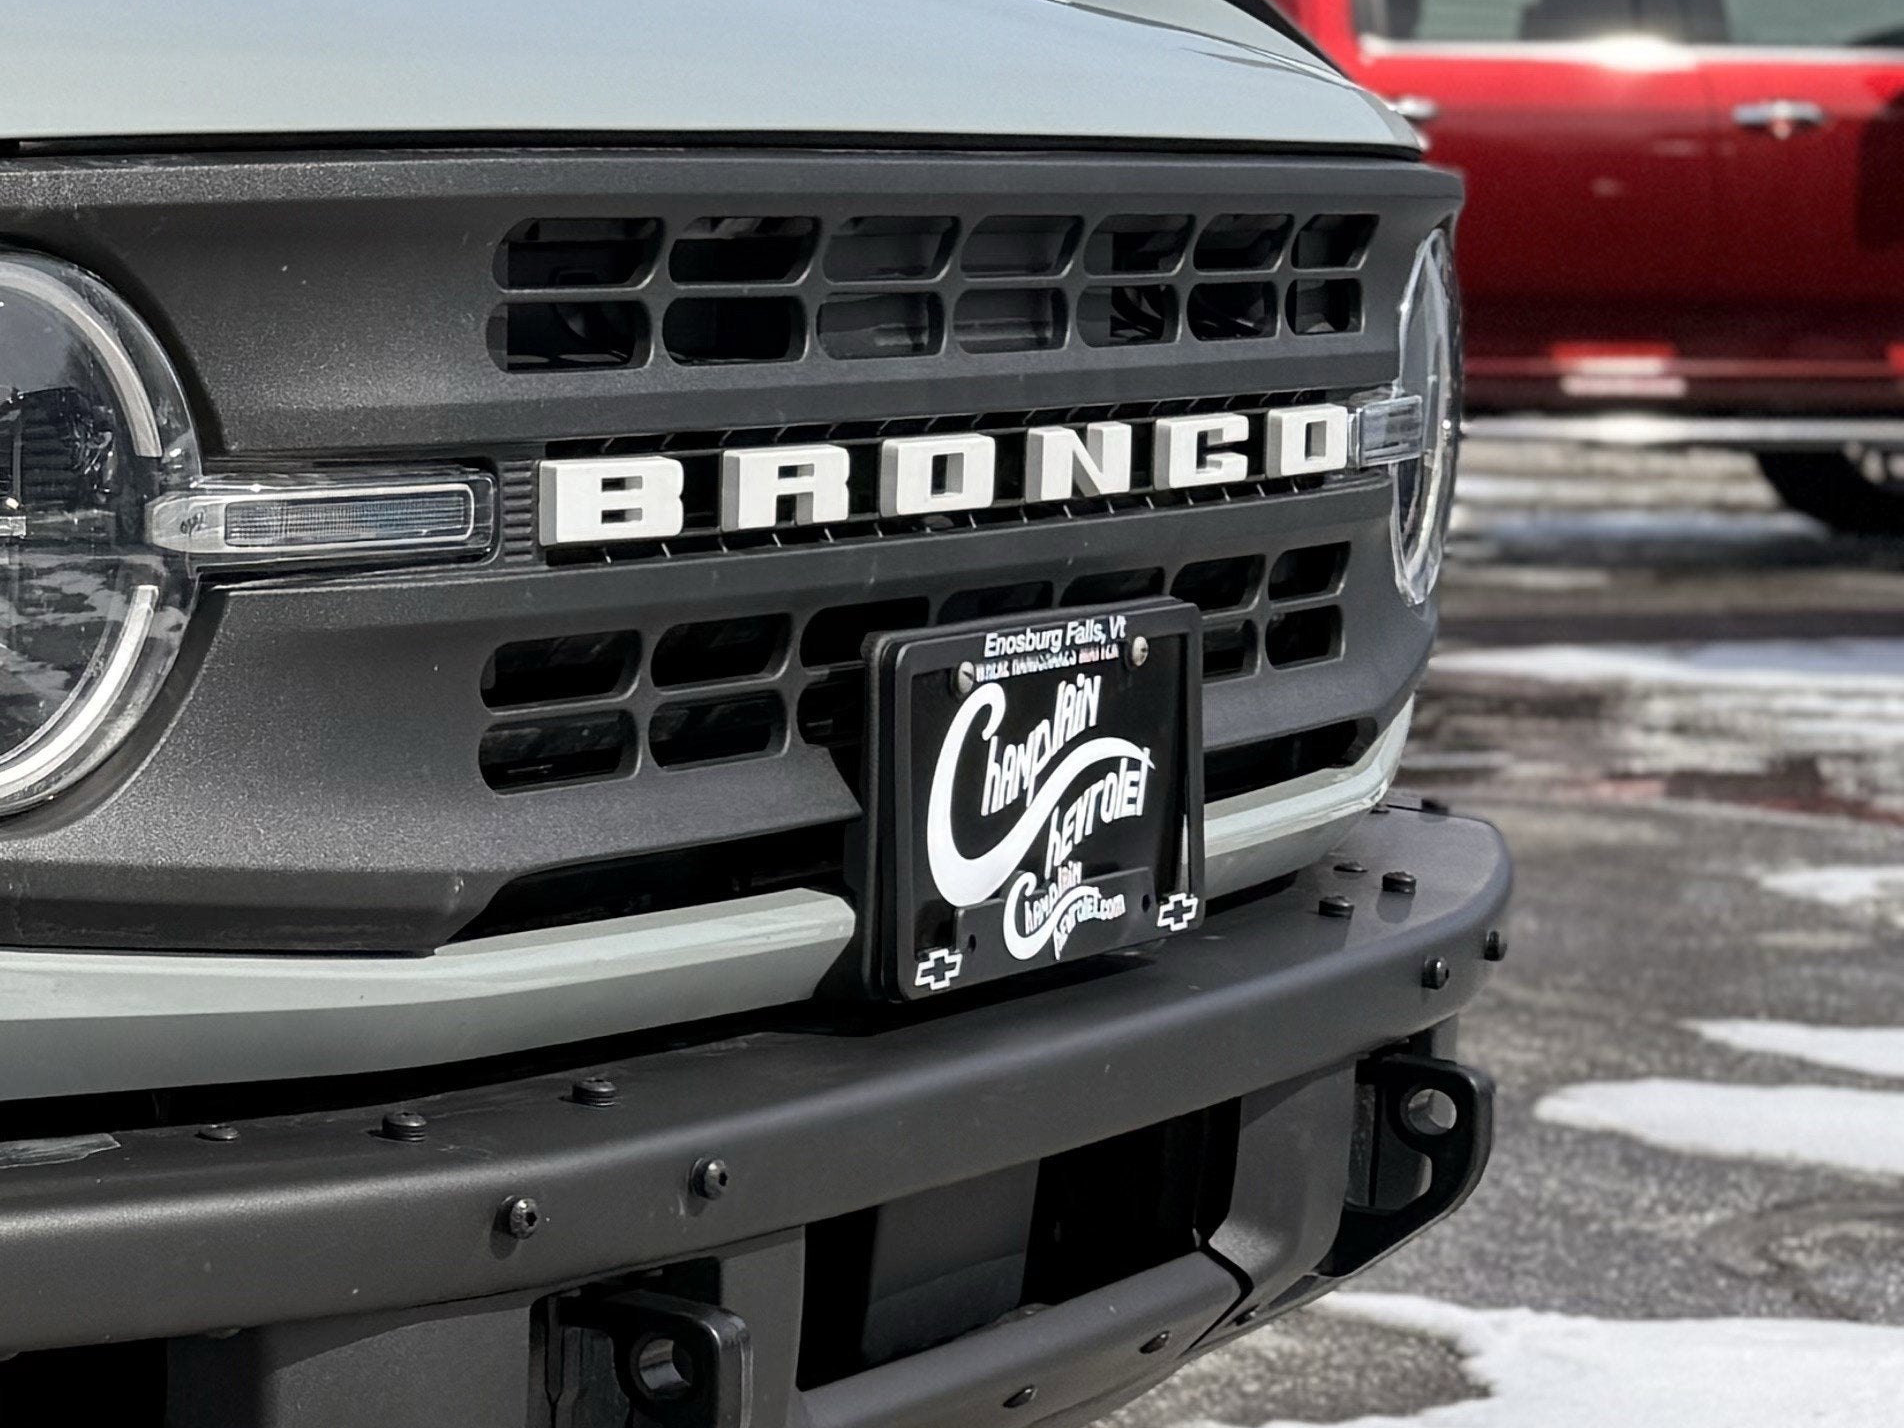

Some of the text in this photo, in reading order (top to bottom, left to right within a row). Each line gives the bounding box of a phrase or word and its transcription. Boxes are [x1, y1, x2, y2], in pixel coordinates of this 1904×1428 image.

[538, 403, 1349, 548] BRONCO
[984, 614, 1127, 657] Enosburg Falls, Vt
